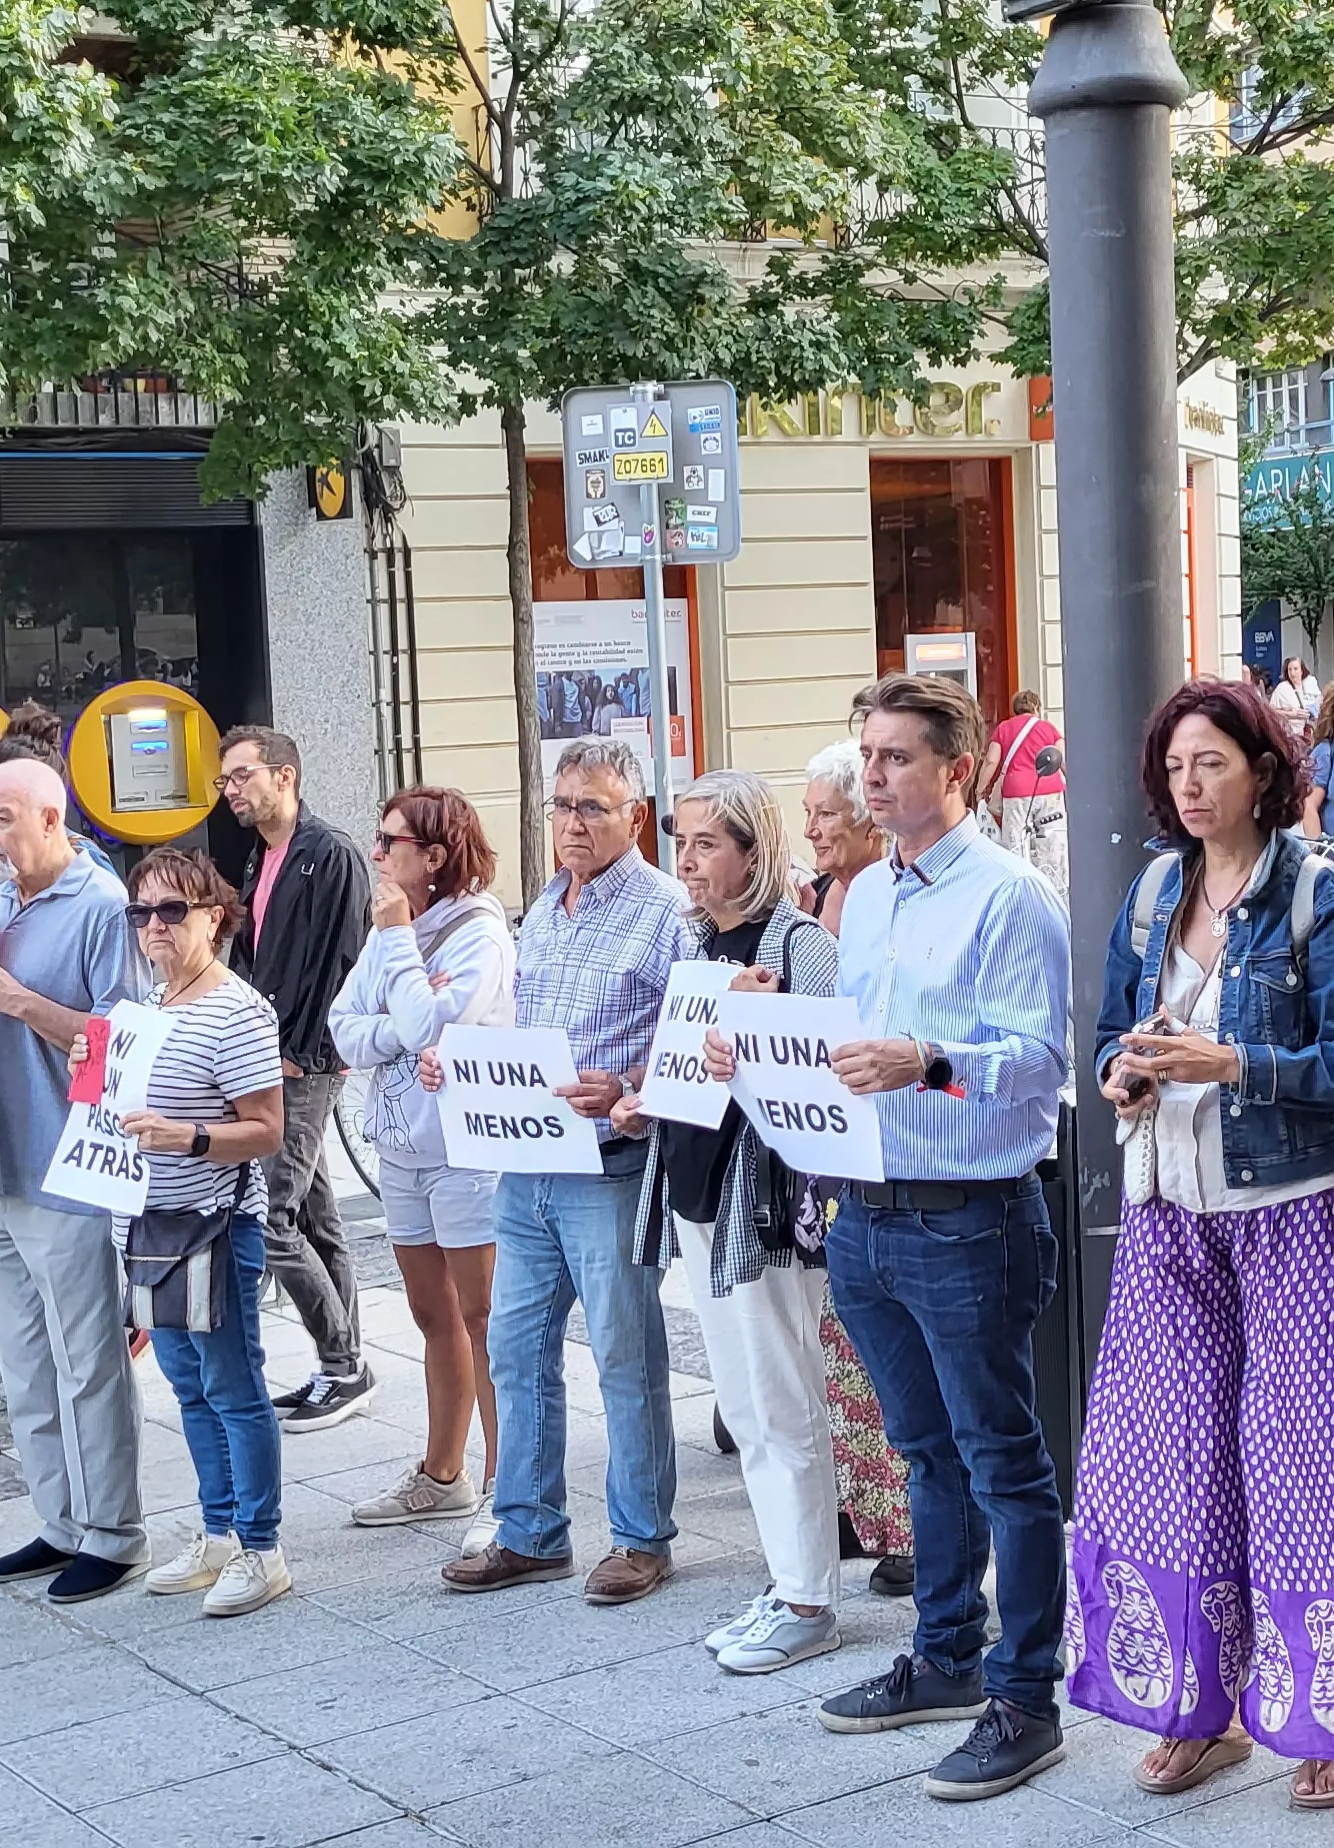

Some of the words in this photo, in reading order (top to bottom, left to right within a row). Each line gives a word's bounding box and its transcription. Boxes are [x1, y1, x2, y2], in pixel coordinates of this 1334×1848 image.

[616, 431, 635, 445] TC
[1254, 630, 1275, 643] BBVA
[667, 994, 685, 1022] NI
[109, 1028, 138, 1061] NI
[734, 1031, 761, 1063] NI
[768, 1035, 832, 1069] UNA
[452, 1058, 481, 1085] NI
[486, 1060, 549, 1088] UNA
[464, 1111, 565, 1139] MENOS
